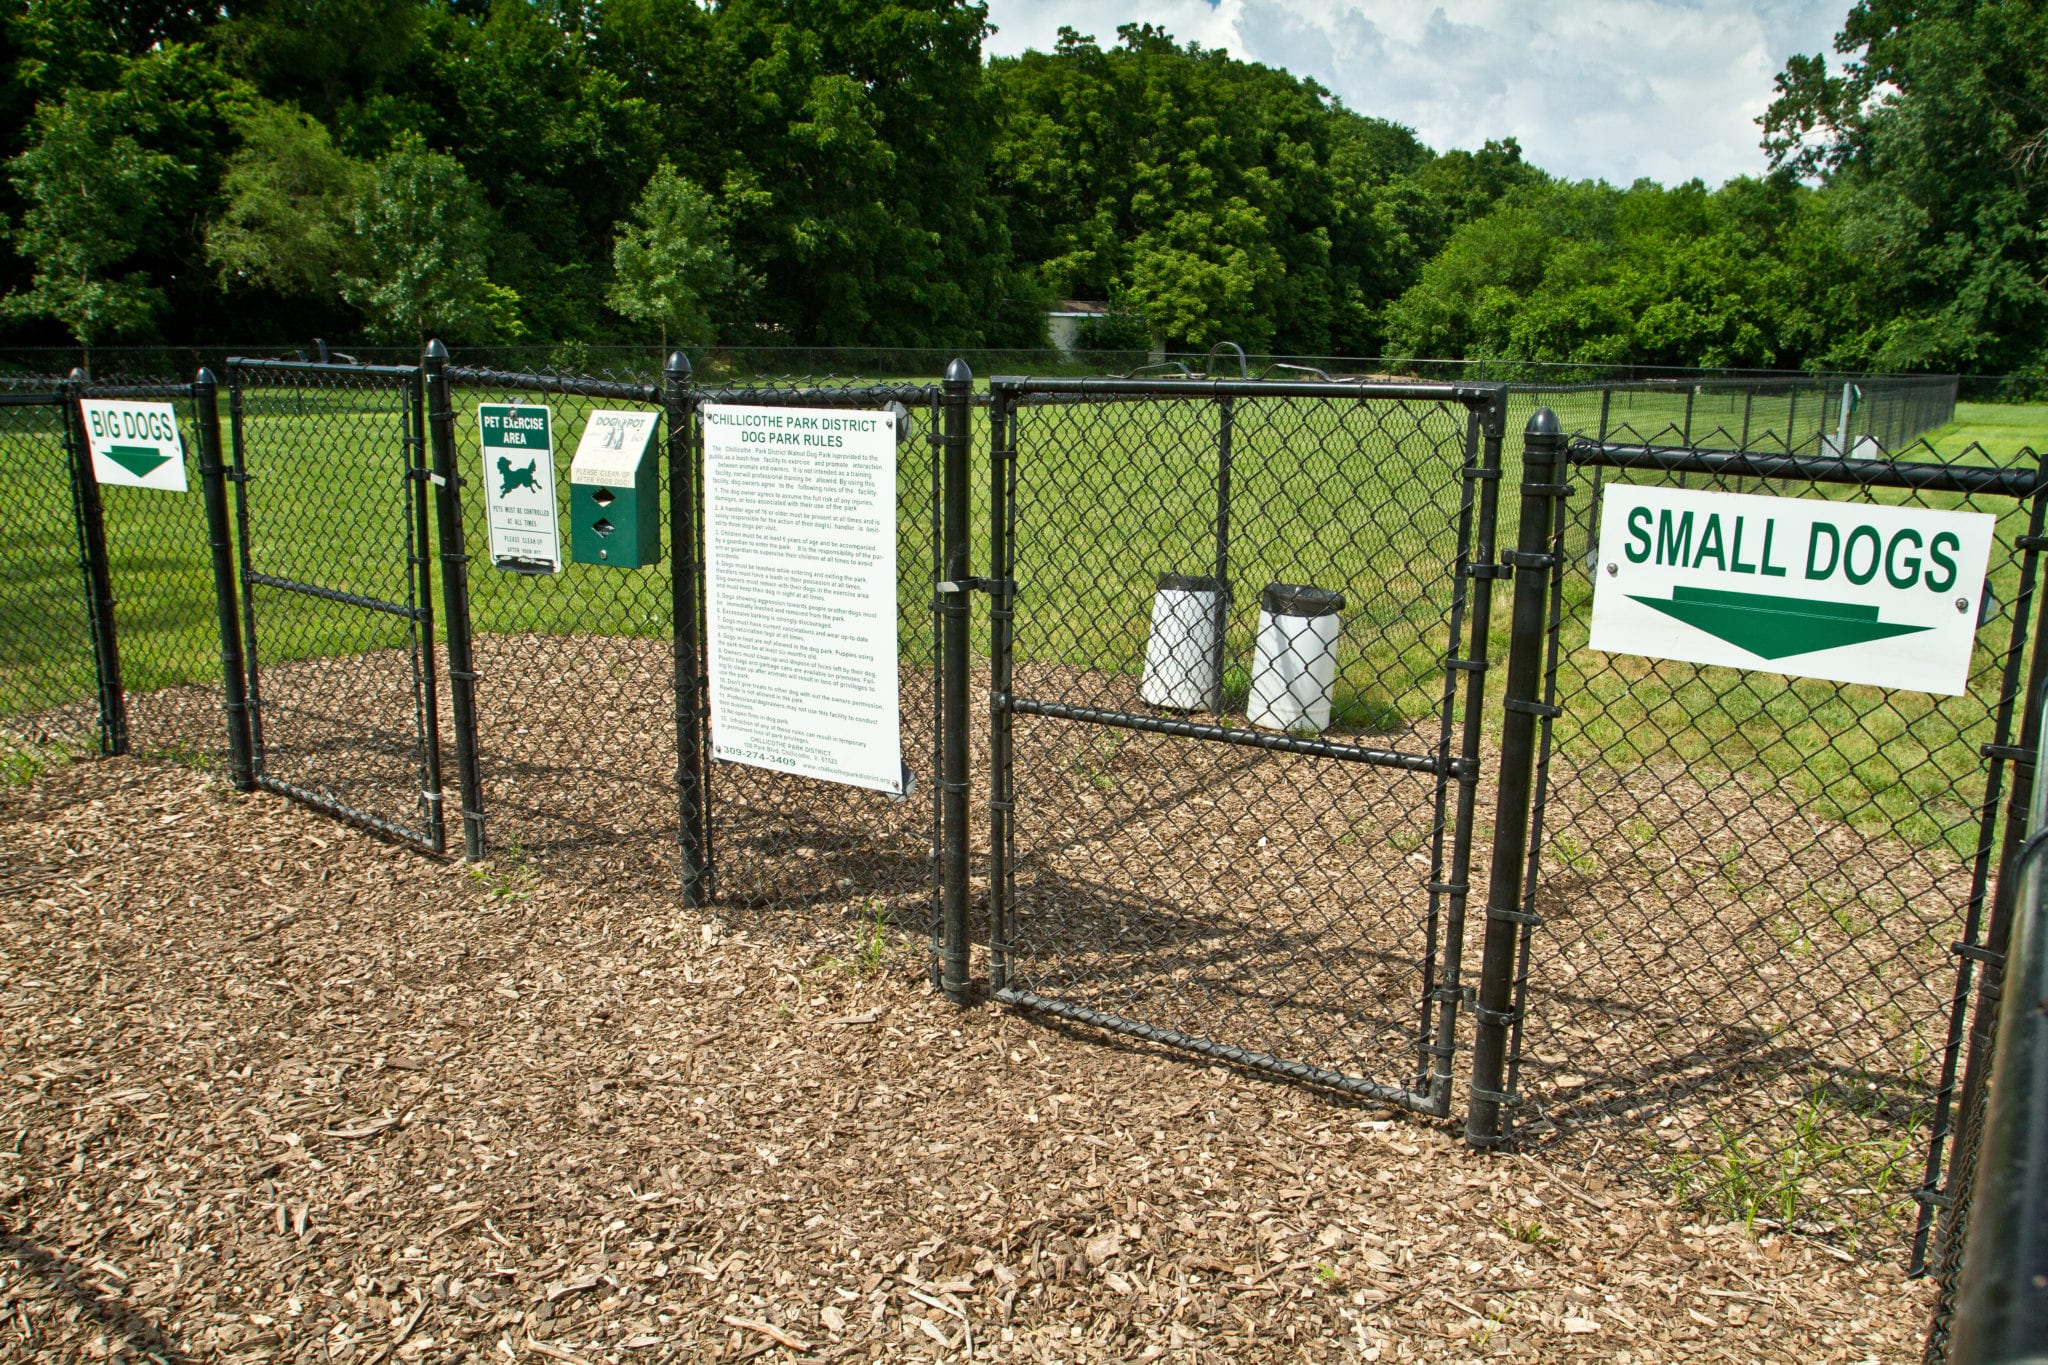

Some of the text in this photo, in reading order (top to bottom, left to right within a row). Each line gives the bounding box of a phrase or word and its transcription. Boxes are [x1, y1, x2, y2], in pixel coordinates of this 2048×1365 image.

[90, 410, 174, 441] BIG DOGS
[484, 416, 544, 430] PET EXERCISE
[712, 413, 877, 433] CHILLICOTHE PARK DISTRICT
[503, 432, 527, 445] AREA
[741, 430, 843, 448] DOG PARK RULES
[576, 468, 598, 476] PLEASE
[1624, 506, 1961, 594] SMALL DOGS
[723, 745, 796, 767] 309-274-3409
[750, 736, 831, 757] CHILLICOTHE PARK DISTRICT
